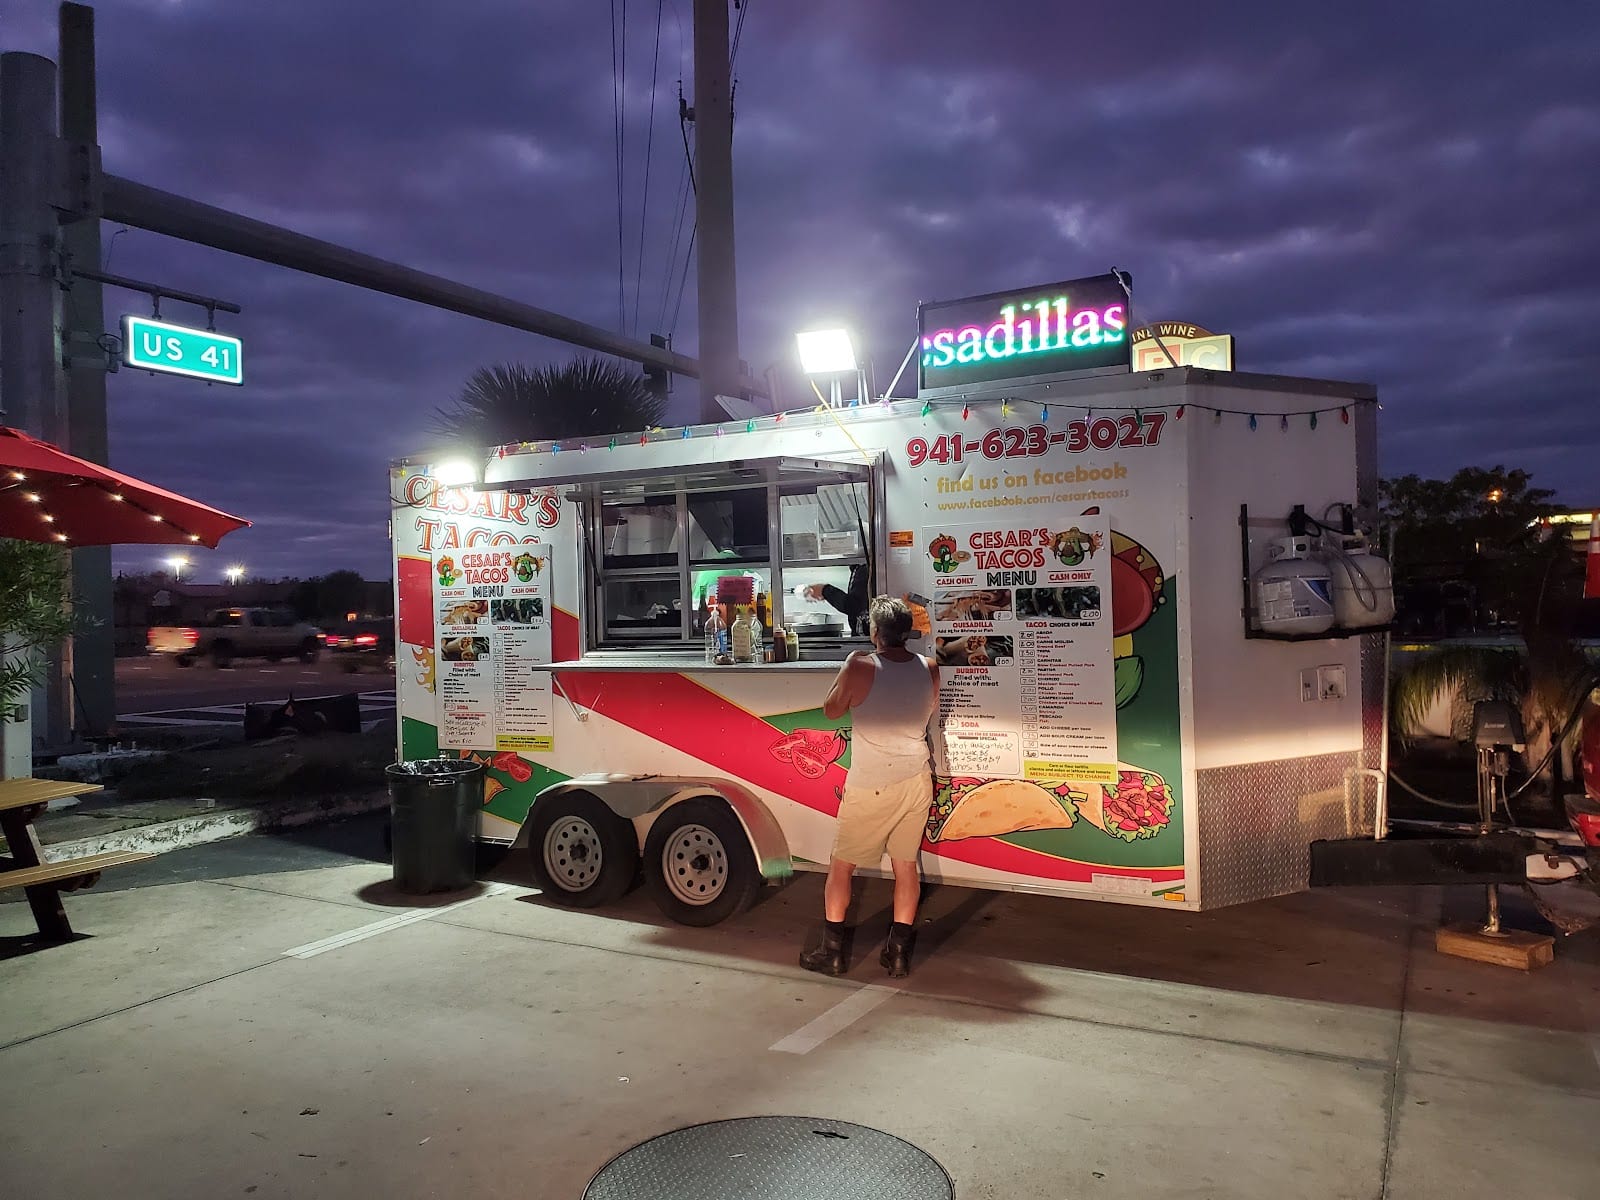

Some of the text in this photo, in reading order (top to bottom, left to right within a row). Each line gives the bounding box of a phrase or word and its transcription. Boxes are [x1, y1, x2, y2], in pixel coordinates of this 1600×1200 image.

[923, 297, 1126, 367] sadillas
[1160, 324, 1197, 338] WINE
[143, 332, 230, 371] US 41
[906, 411, 1167, 468] 941-623-3027
[937, 462, 1128, 494] find us on facebook
[969, 528, 1050, 550] CESAR'S
[462, 552, 511, 568] CESAR'S
[974, 549, 1045, 570] TACOS
[464, 568, 509, 585] TACOS
[936, 577, 974, 586] CASH ONLY
[986, 571, 1037, 587] MENU
[1049, 572, 1092, 581] CASH ONLY
[472, 585, 504, 598] MENU
